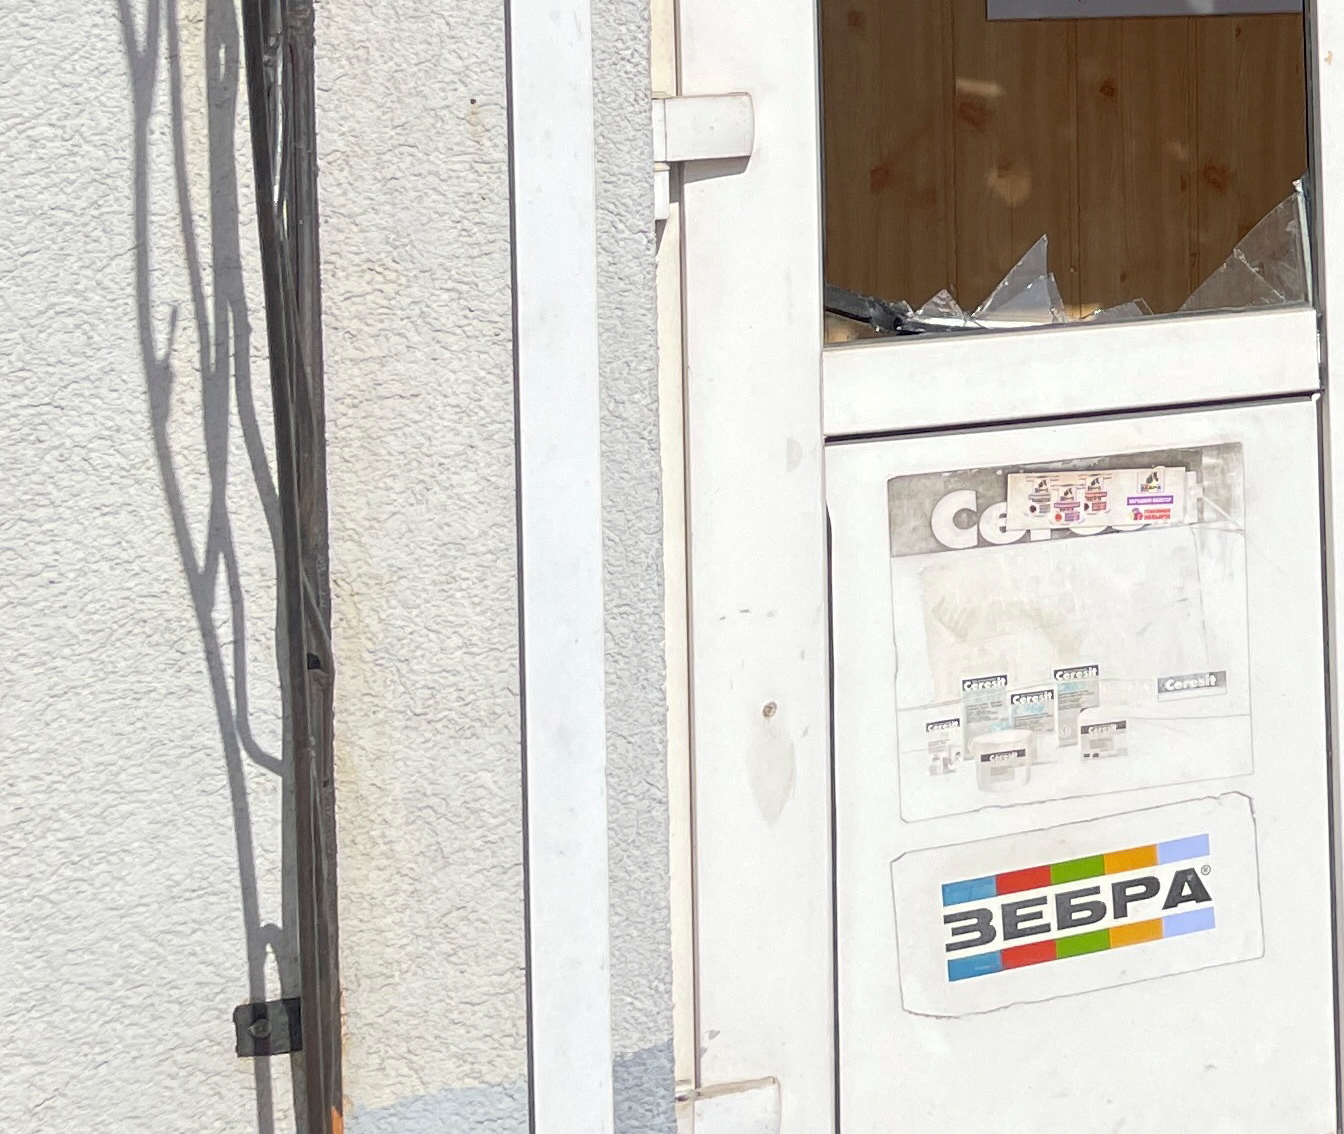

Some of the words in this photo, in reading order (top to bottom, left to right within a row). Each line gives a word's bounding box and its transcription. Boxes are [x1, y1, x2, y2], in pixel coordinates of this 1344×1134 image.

[1055, 667, 1098, 681] Ceresit
[1165, 673, 1217, 691] Ceresit
[963, 676, 1007, 692] Ceresit
[1012, 691, 1054, 706] Ceresit
[943, 867, 1212, 952] ЗЕБРА
